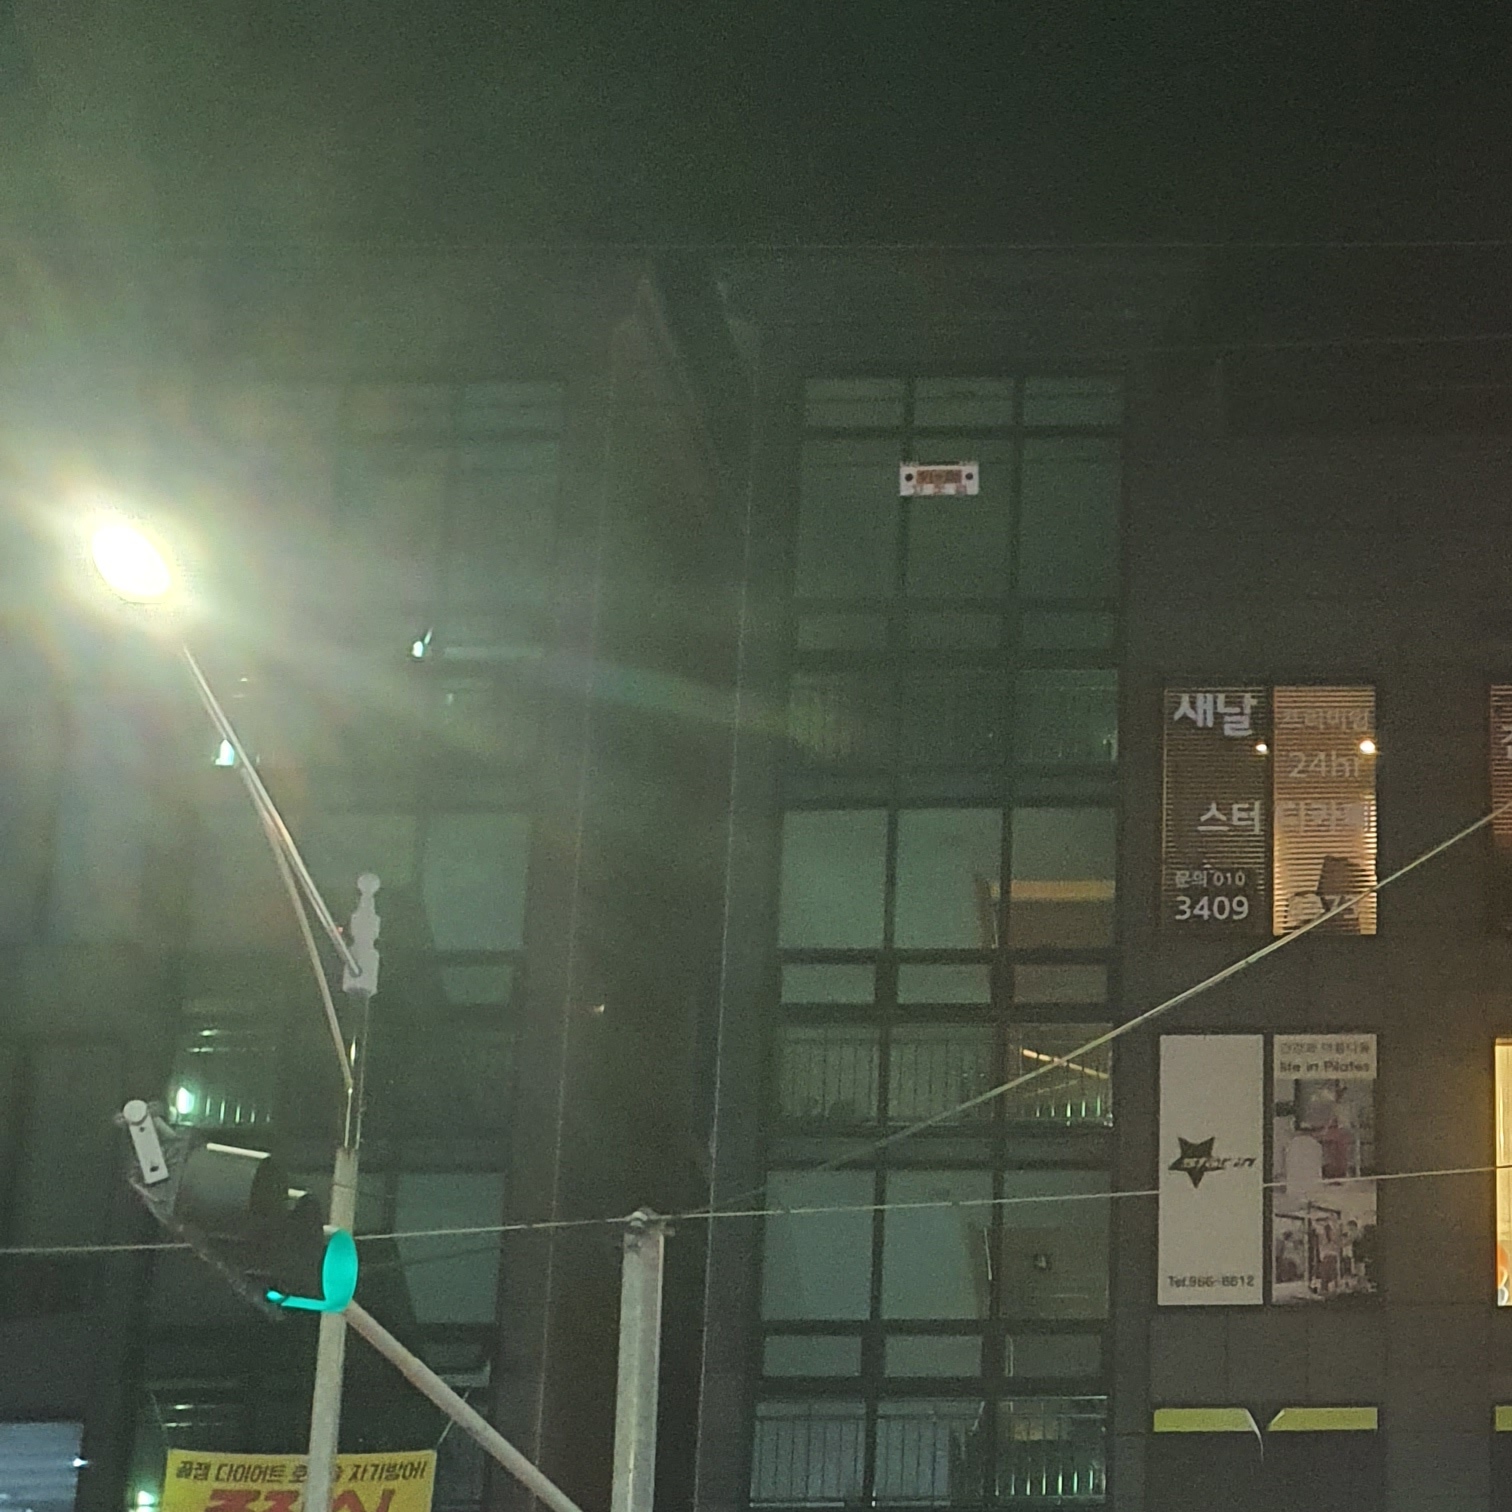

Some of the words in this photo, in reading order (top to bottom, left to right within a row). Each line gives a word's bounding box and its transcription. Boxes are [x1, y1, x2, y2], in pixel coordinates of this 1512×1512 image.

[1173, 692, 1258, 737] 새날
[1212, 870, 1247, 886] 010
[1174, 895, 1250, 921] 3409
[215, 1463, 287, 1483] 다이어트
